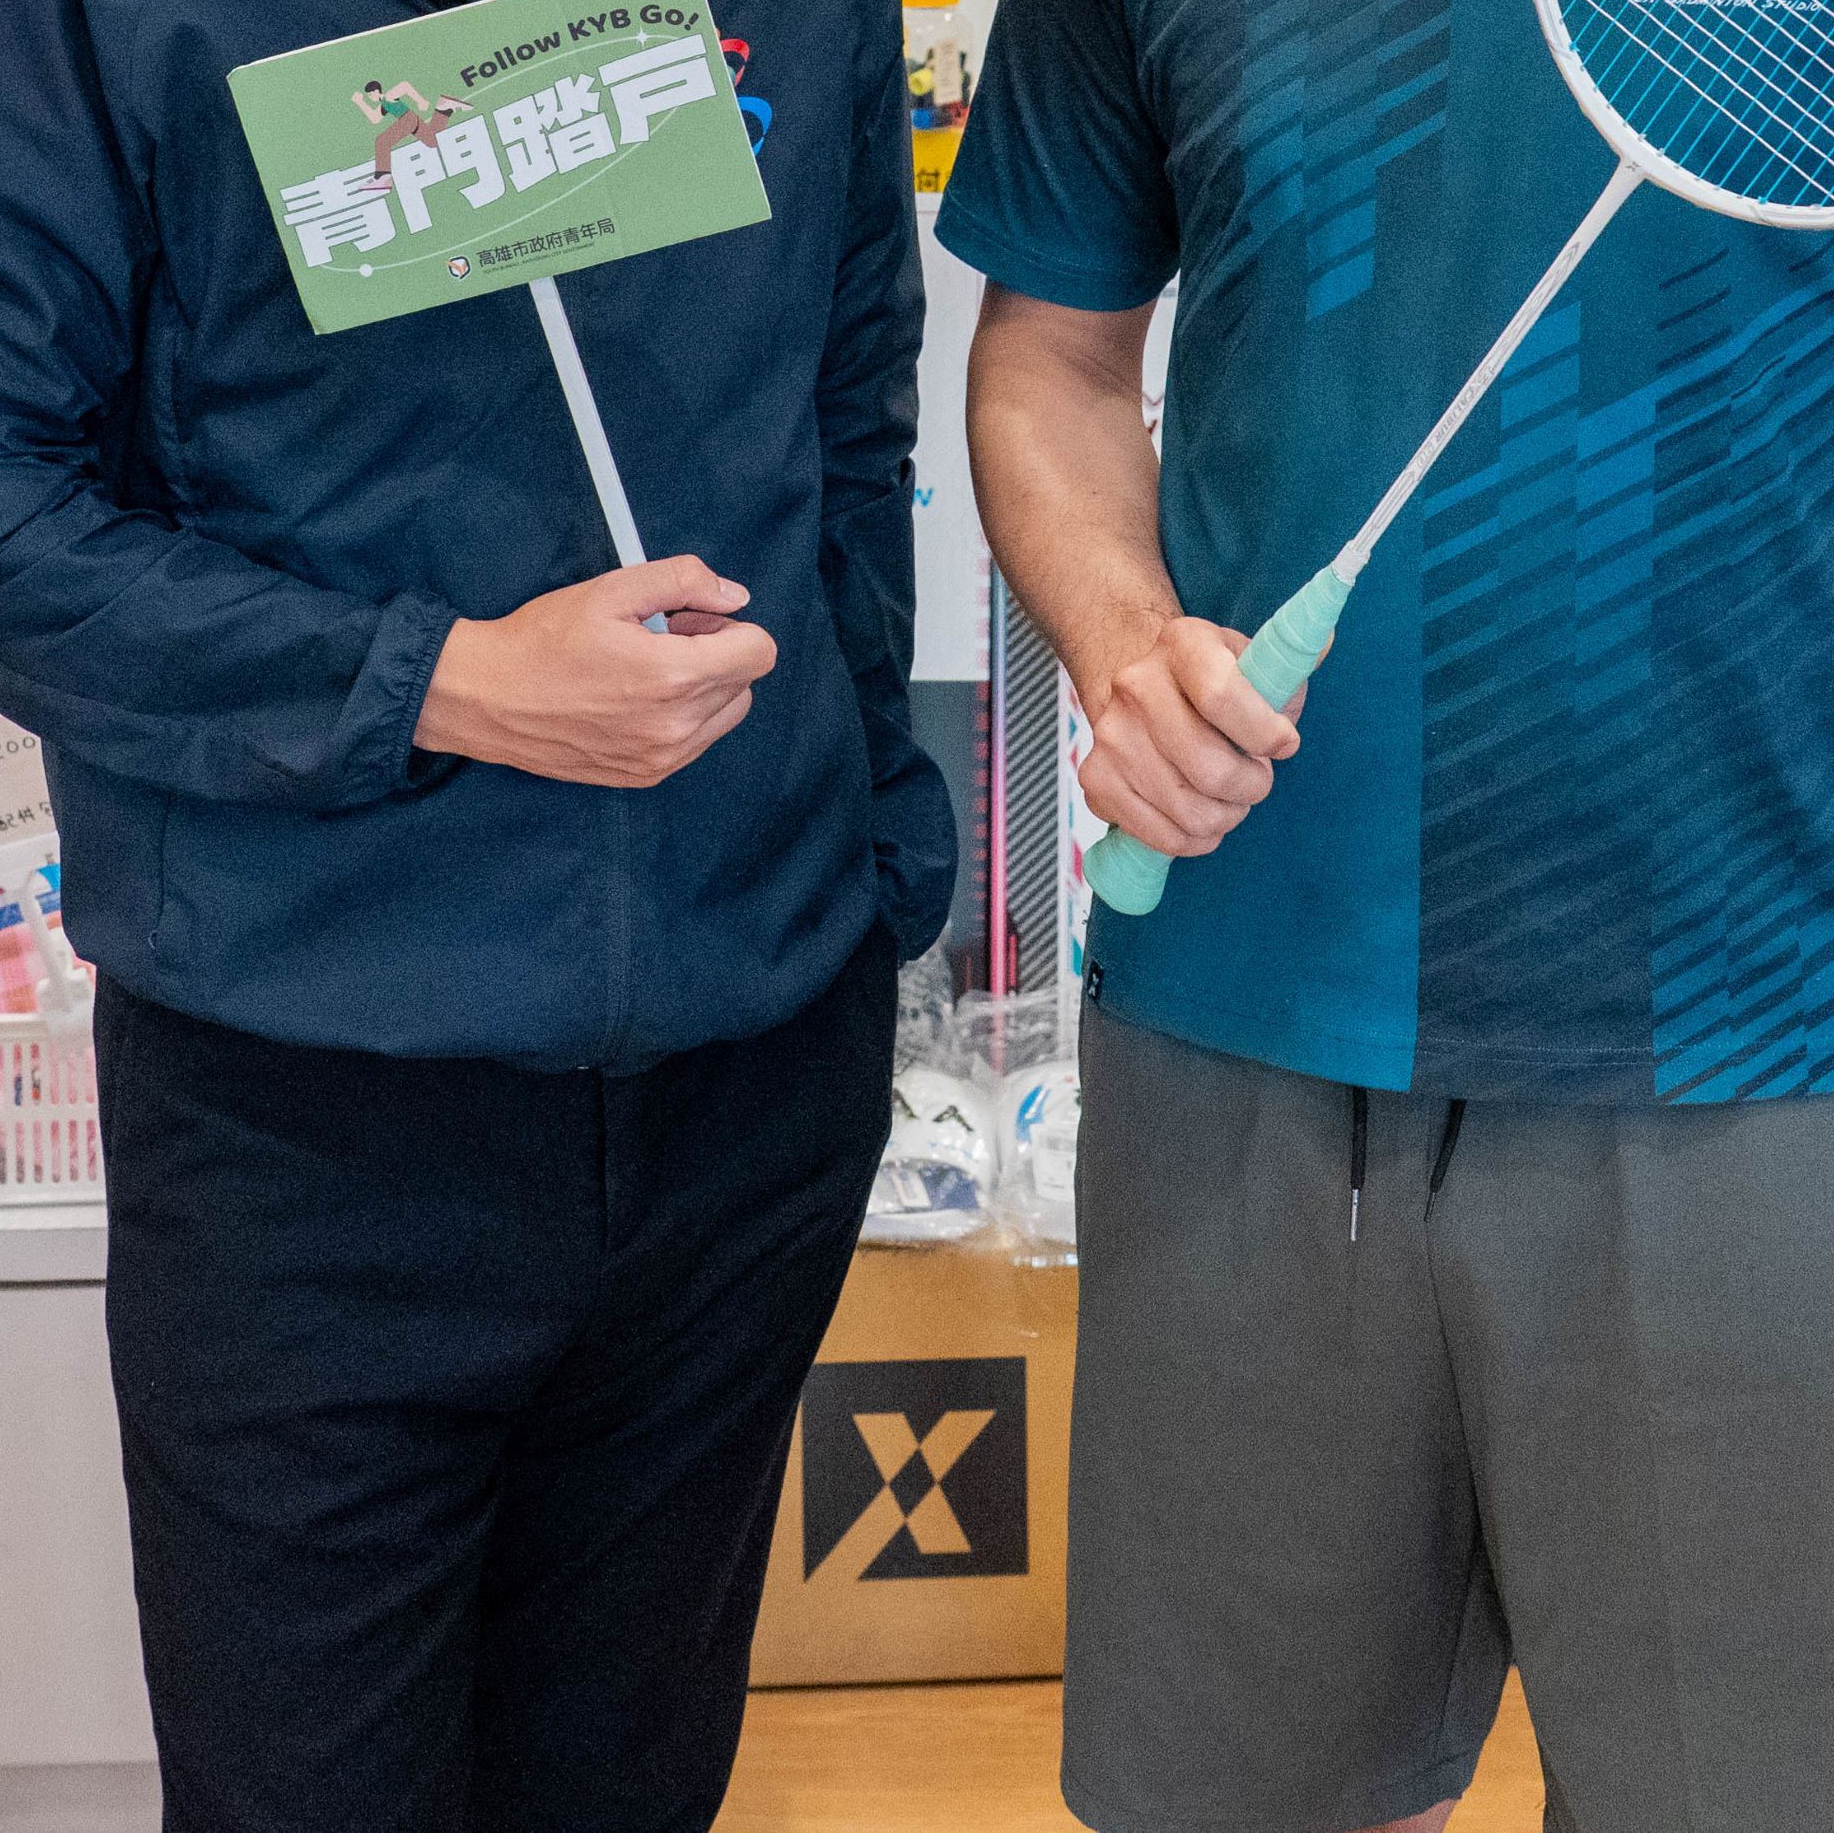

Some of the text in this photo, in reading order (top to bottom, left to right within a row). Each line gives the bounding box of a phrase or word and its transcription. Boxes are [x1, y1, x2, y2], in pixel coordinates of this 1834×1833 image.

[460, 4, 700, 88] Follow KYB Go!
[476, 216, 616, 269] 高雄市政府青年局
